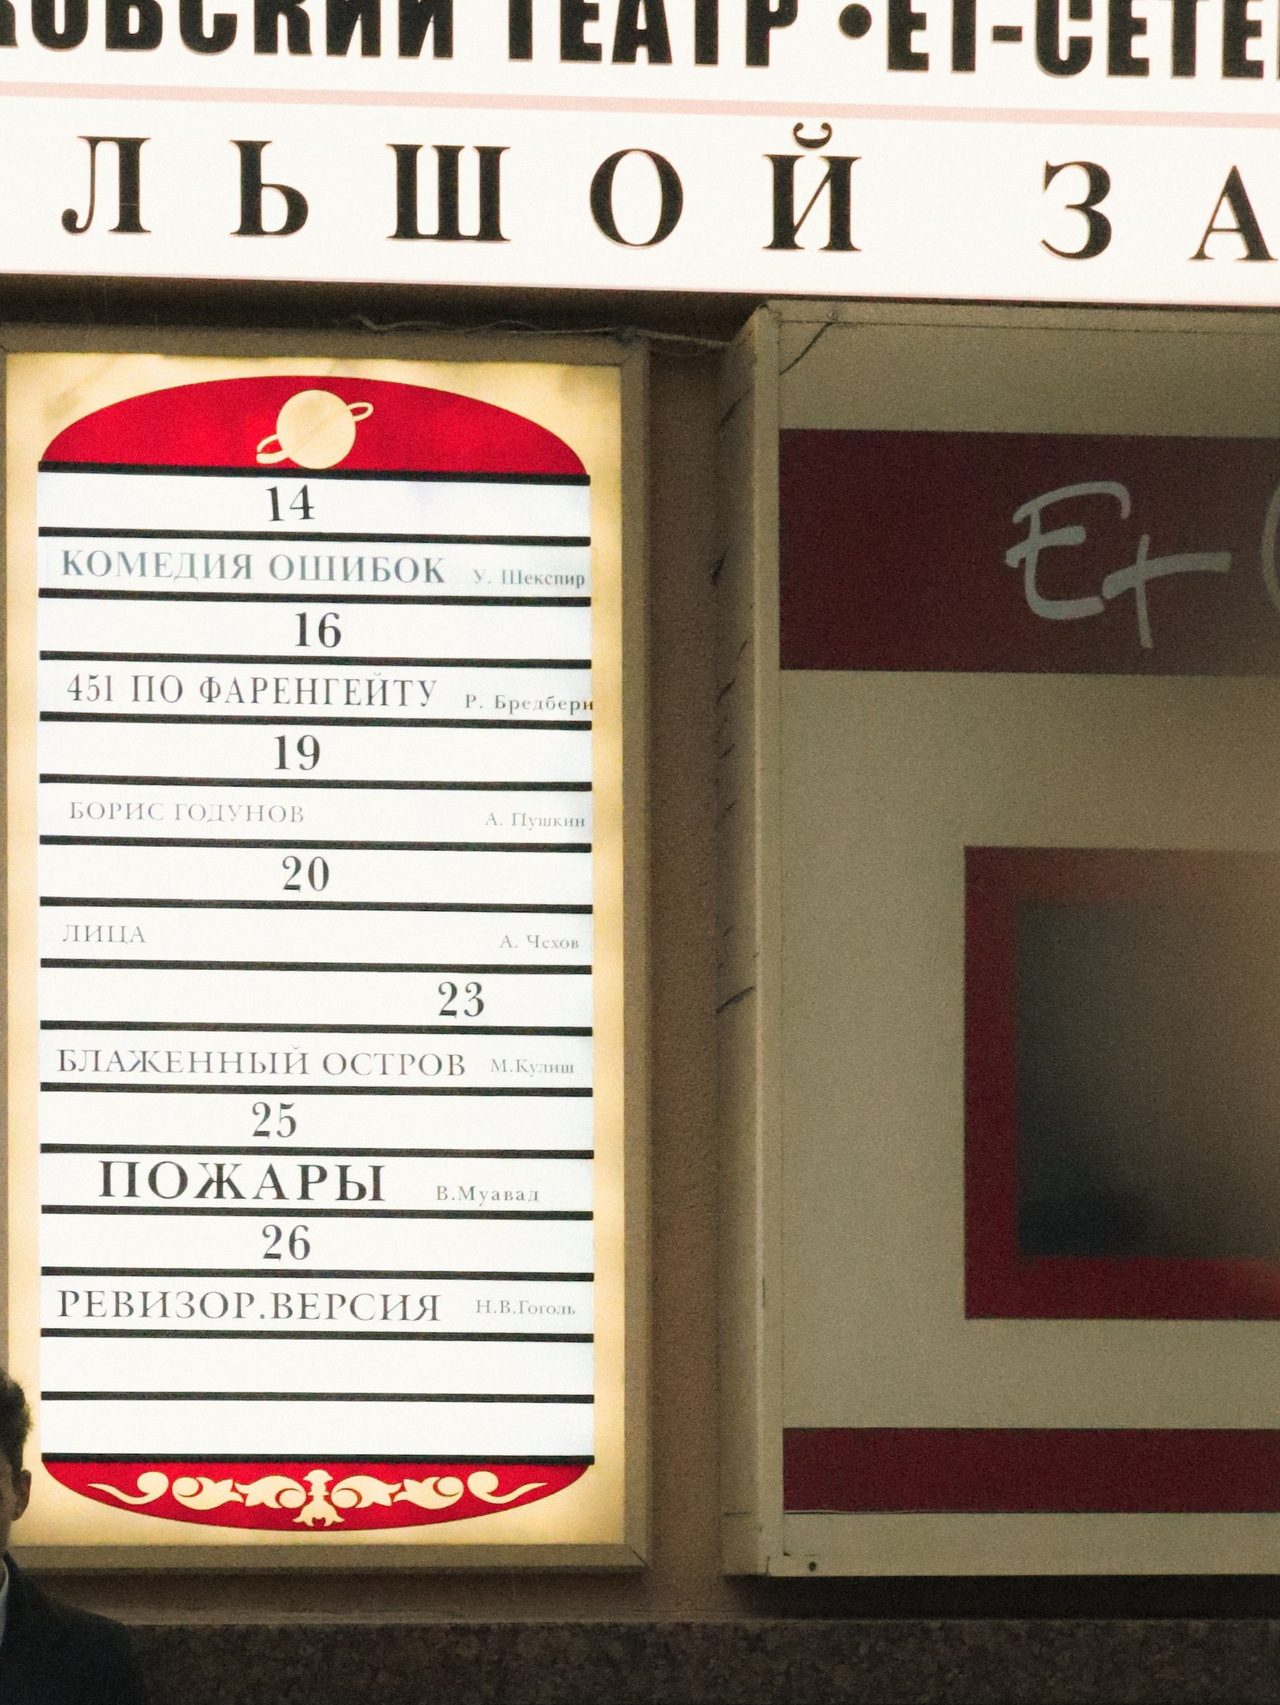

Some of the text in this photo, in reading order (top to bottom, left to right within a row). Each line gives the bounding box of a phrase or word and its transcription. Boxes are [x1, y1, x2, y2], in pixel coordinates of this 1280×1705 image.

[265, 484, 316, 523] 14
[60, 549, 586, 589] КОМЕДИЯ ОШИБОК У. Шекспир
[294, 611, 342, 649] 16
[67, 673, 114, 703] 451
[131, 674, 184, 703] ПО
[199, 672, 437, 707] ФАРЕНГЕЙТУ
[465, 694, 484, 709] Р.
[273, 734, 322, 771] 19
[69, 801, 586, 830] БОРИС ГОДУНОВ А. Пушкин
[281, 855, 330, 893] 20
[62, 924, 580, 949] ЛИЦА А. Чехов
[437, 981, 485, 1019] 23
[56, 1045, 575, 1077] БЛАЖЕННЫЙ ОСТРОВ М.Кулиш
[251, 1102, 298, 1140] 25
[97, 1160, 540, 1207] ПОЖАРЫ В.Муавад
[261, 1224, 312, 1261] 26
[56, 1289, 577, 1322] РЕВИЗОР.ВЕРСИЯ Н.В.Гоголь
